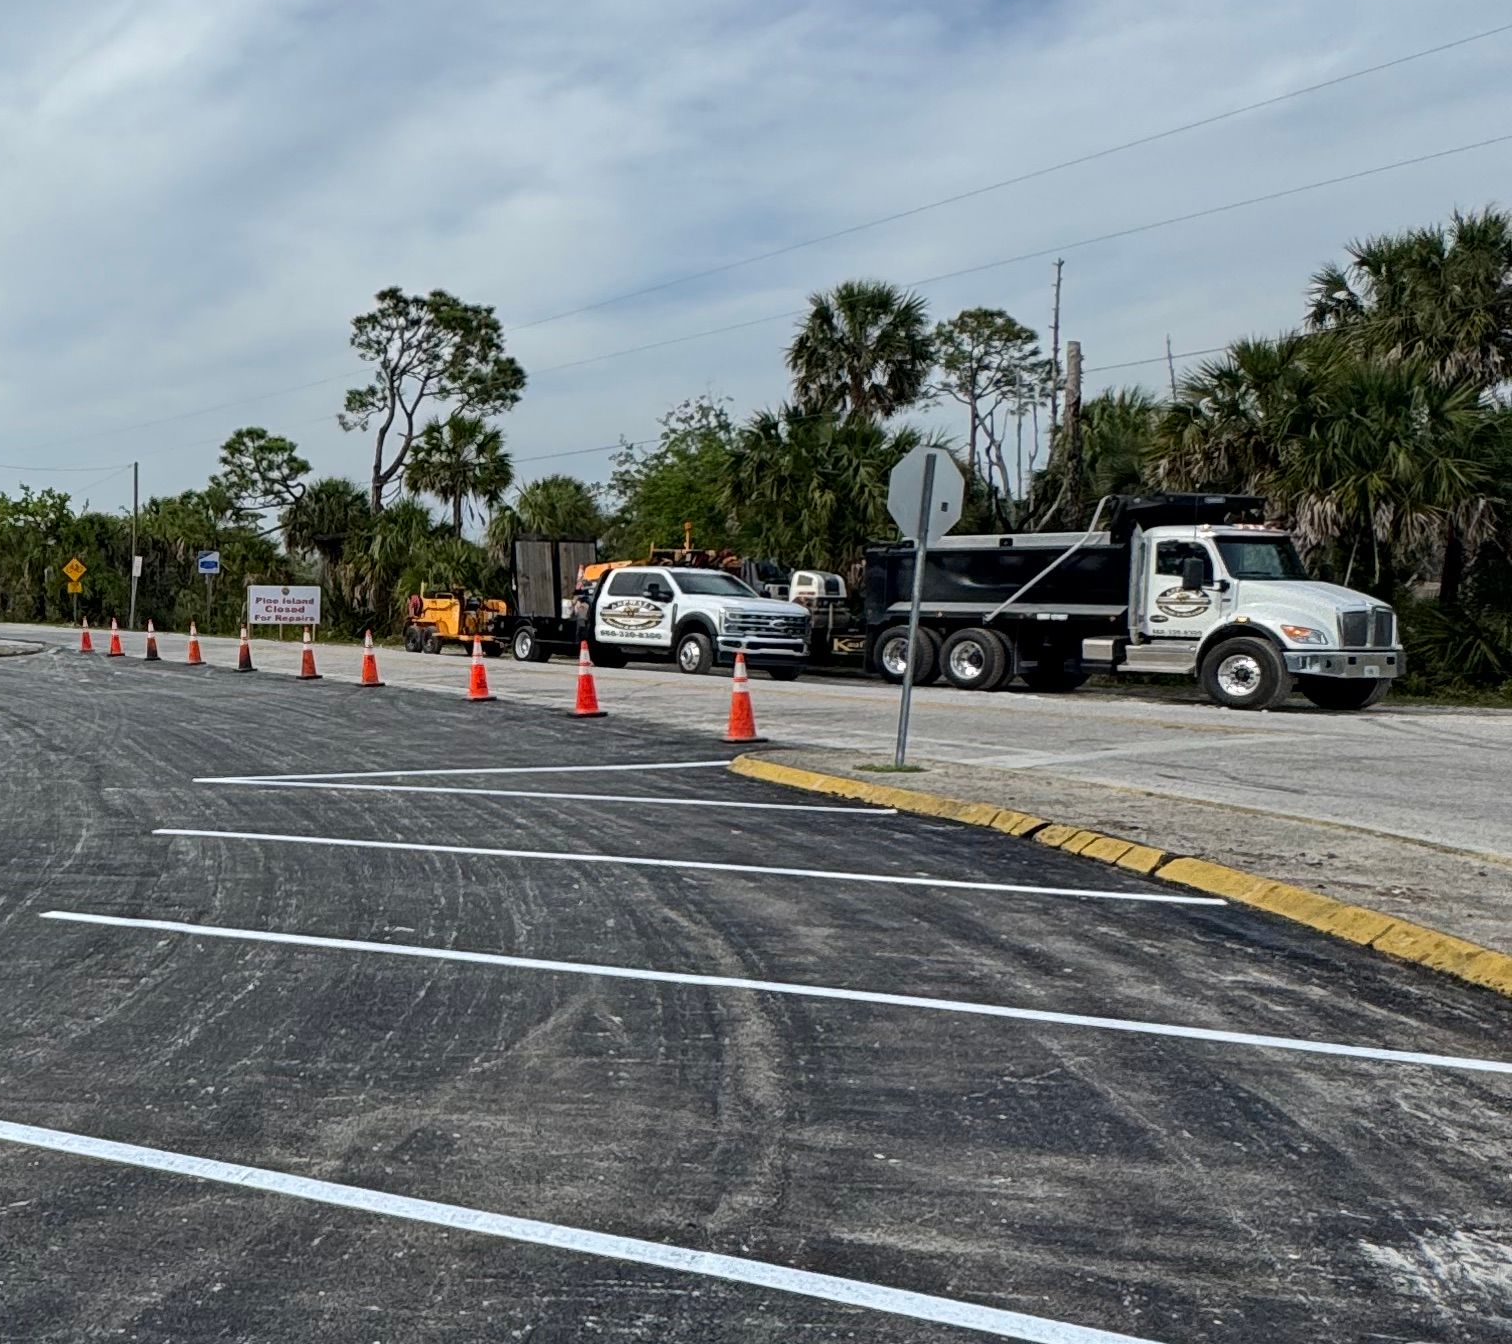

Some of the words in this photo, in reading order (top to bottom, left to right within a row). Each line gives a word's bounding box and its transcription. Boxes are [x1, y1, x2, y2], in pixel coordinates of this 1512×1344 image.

[282, 597, 315, 605] Island
[265, 605, 306, 613] Closed
[254, 614, 272, 622] For
[275, 614, 315, 623] Repairs
